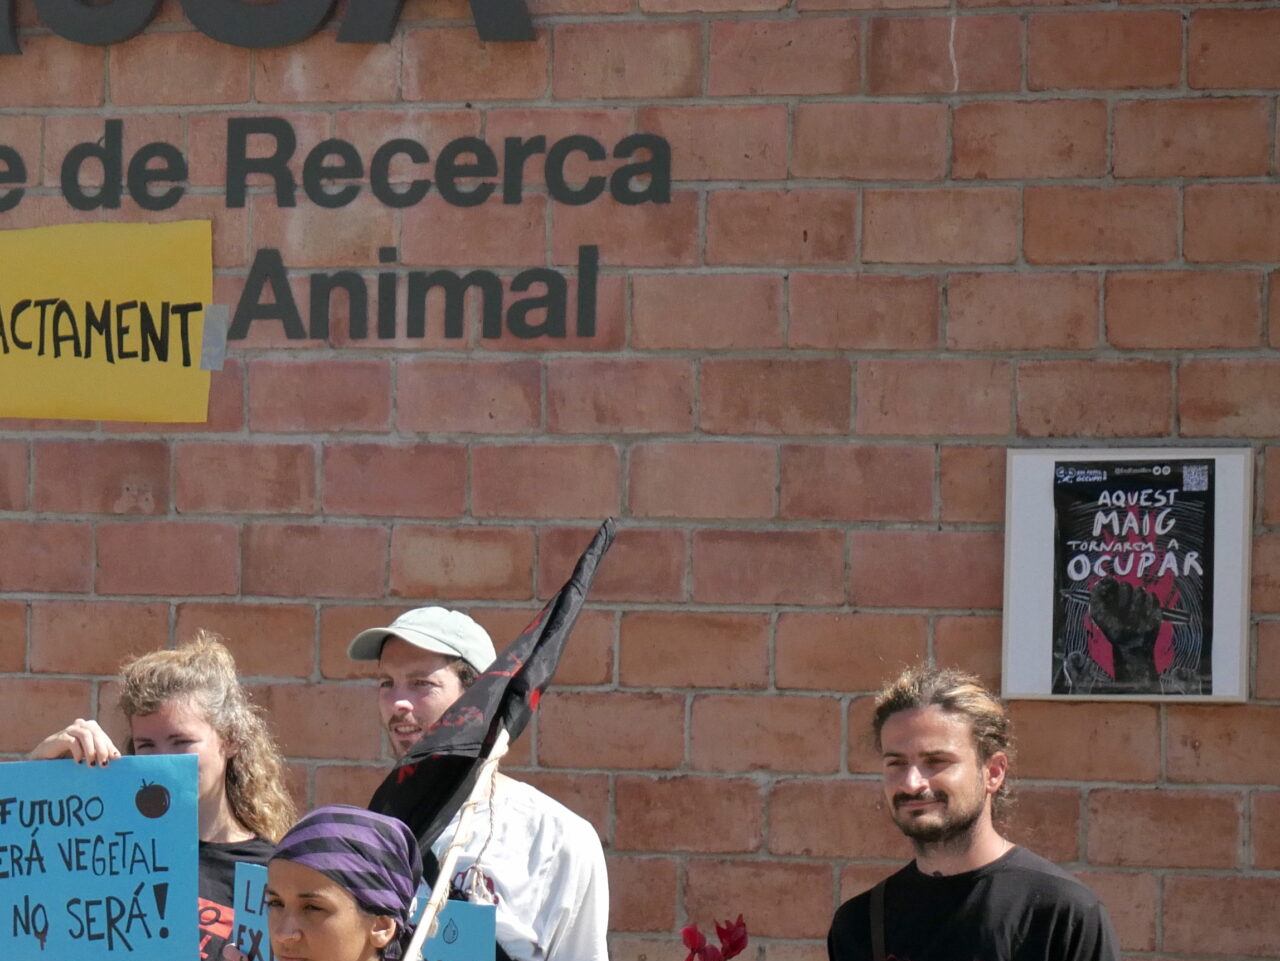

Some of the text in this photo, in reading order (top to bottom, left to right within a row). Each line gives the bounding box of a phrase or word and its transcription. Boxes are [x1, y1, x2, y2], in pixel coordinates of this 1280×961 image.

[61, 118, 189, 212] de
[226, 116, 672, 209] Recerca
[228, 245, 599, 341] Animal
[1098, 488, 1179, 507] AQUEST
[1092, 508, 1176, 537] MAIG
[1167, 538, 1179, 550] A
[1067, 551, 1204, 581] OCUPAR
[58, 831, 169, 876] VEGETAL
[13, 895, 50, 950] NO
[66, 881, 170, 952] SERÁ!
